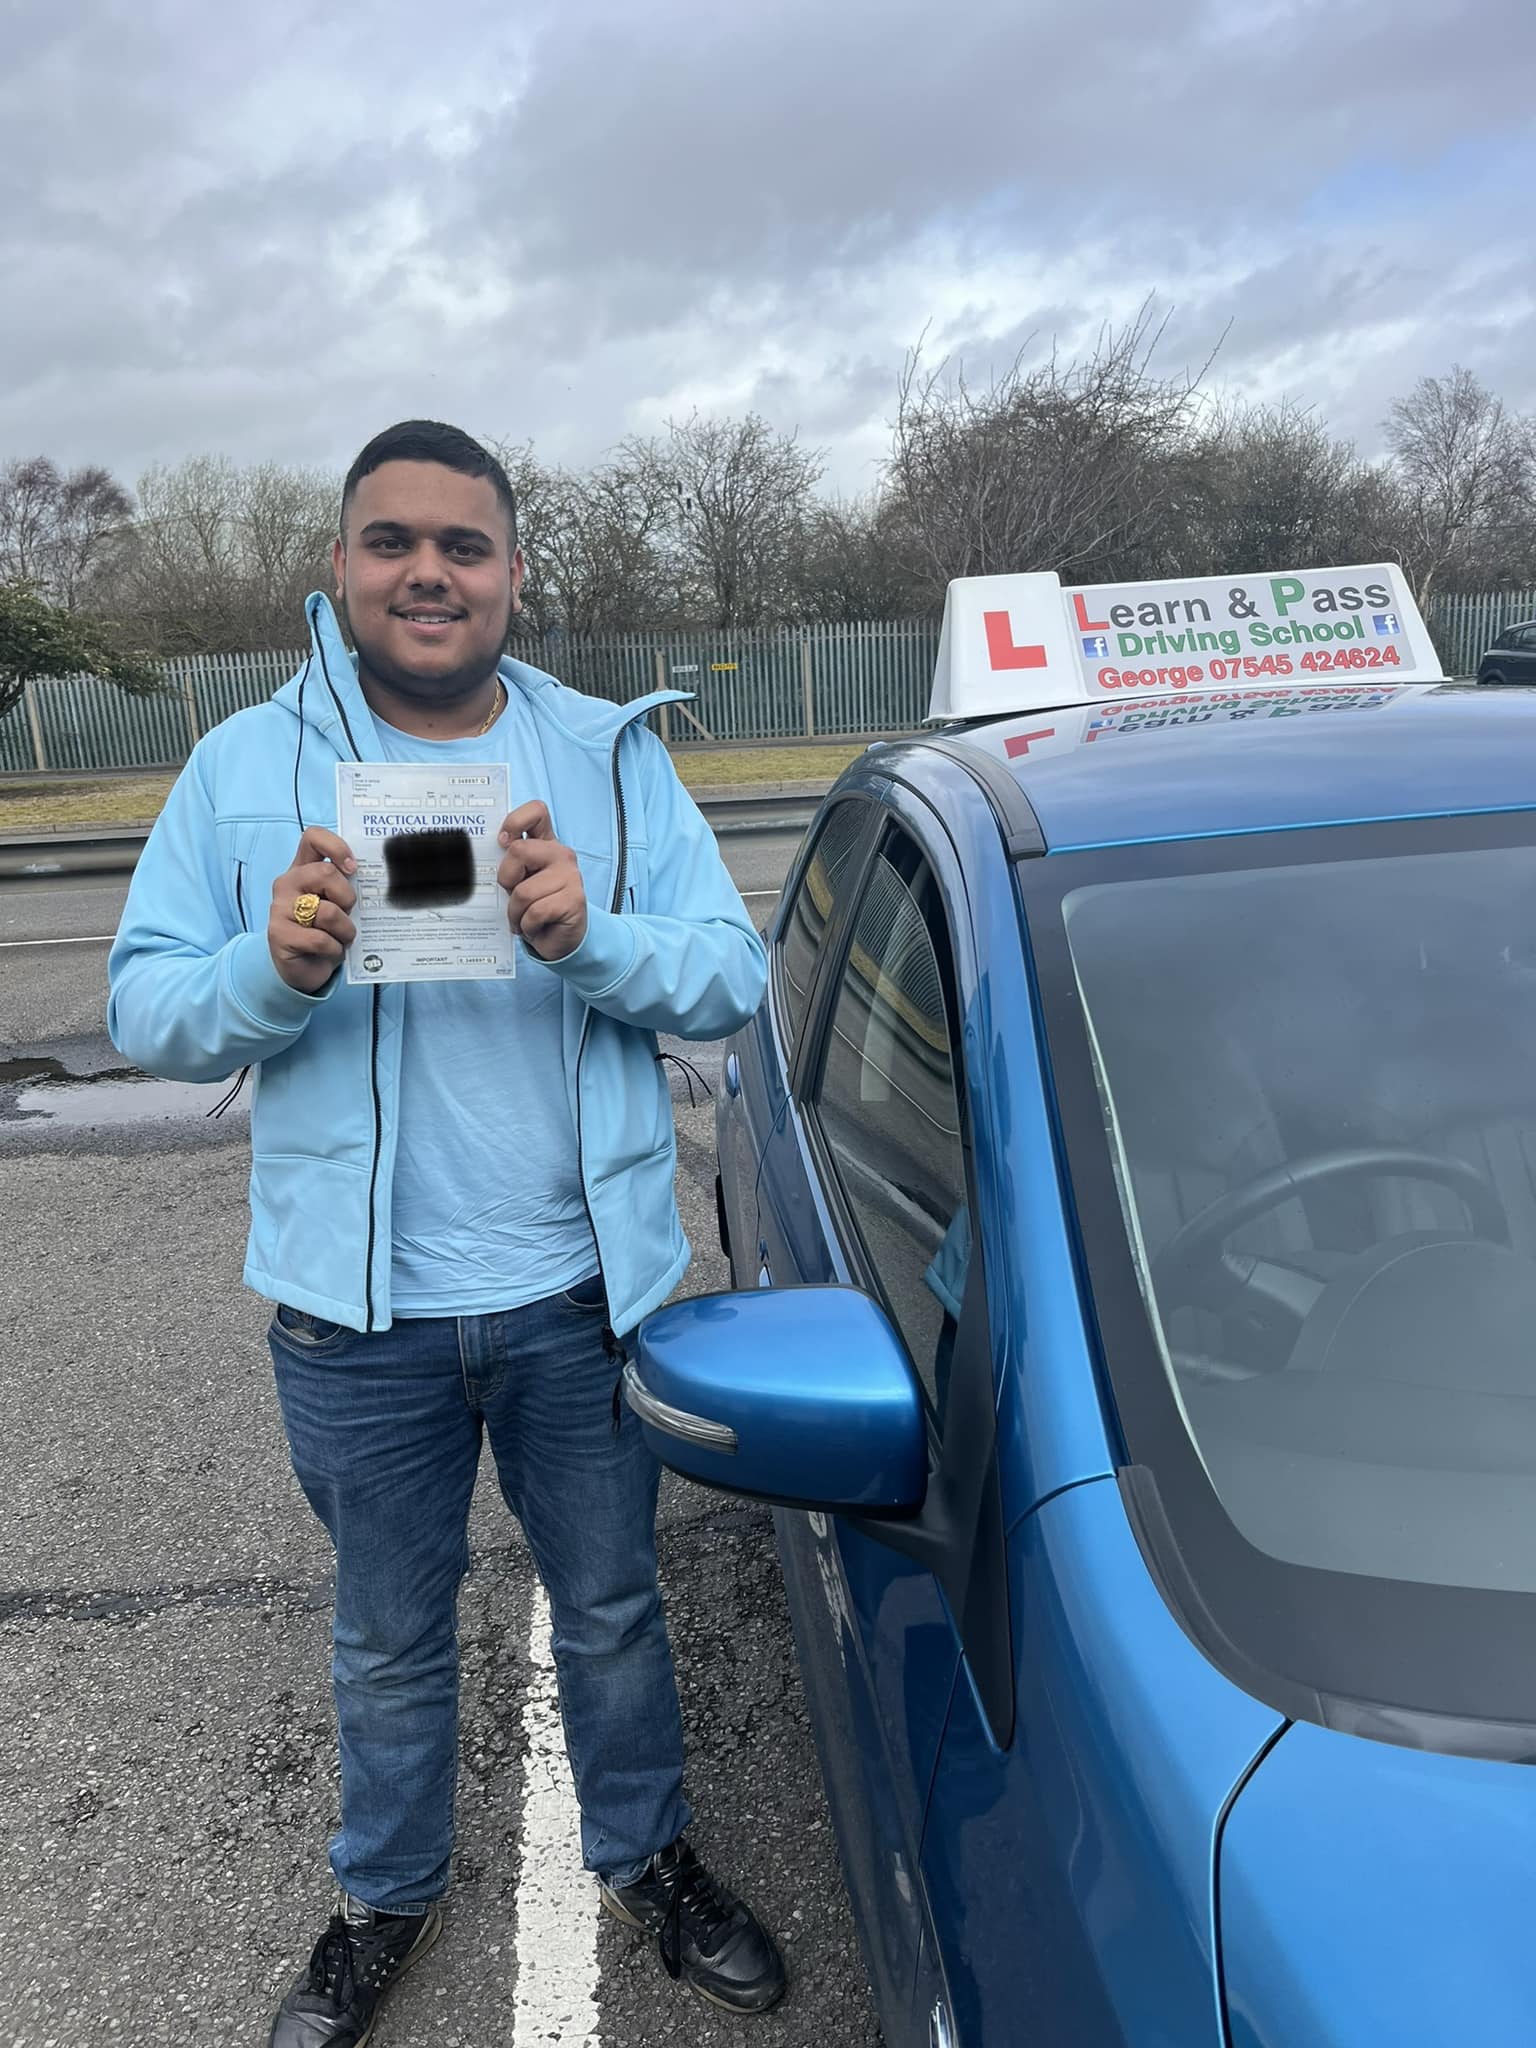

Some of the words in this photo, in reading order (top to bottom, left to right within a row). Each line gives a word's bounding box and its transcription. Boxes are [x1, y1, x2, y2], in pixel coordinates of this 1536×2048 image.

[1072, 593, 1212, 632] Learn
[1228, 587, 1261, 619] &
[1269, 577, 1391, 616] Pass
[983, 611, 1048, 671] L
[1116, 628, 1241, 657] Driving
[1248, 615, 1365, 647] School
[1097, 665, 1204, 689] George
[1208, 654, 1293, 681] 07545
[1300, 645, 1400, 672] 424624
[363, 814, 428, 825] PRACTICAL
[431, 814, 486, 825] DRIVING
[364, 826, 388, 837] TEST
[391, 826, 417, 836] PASS
